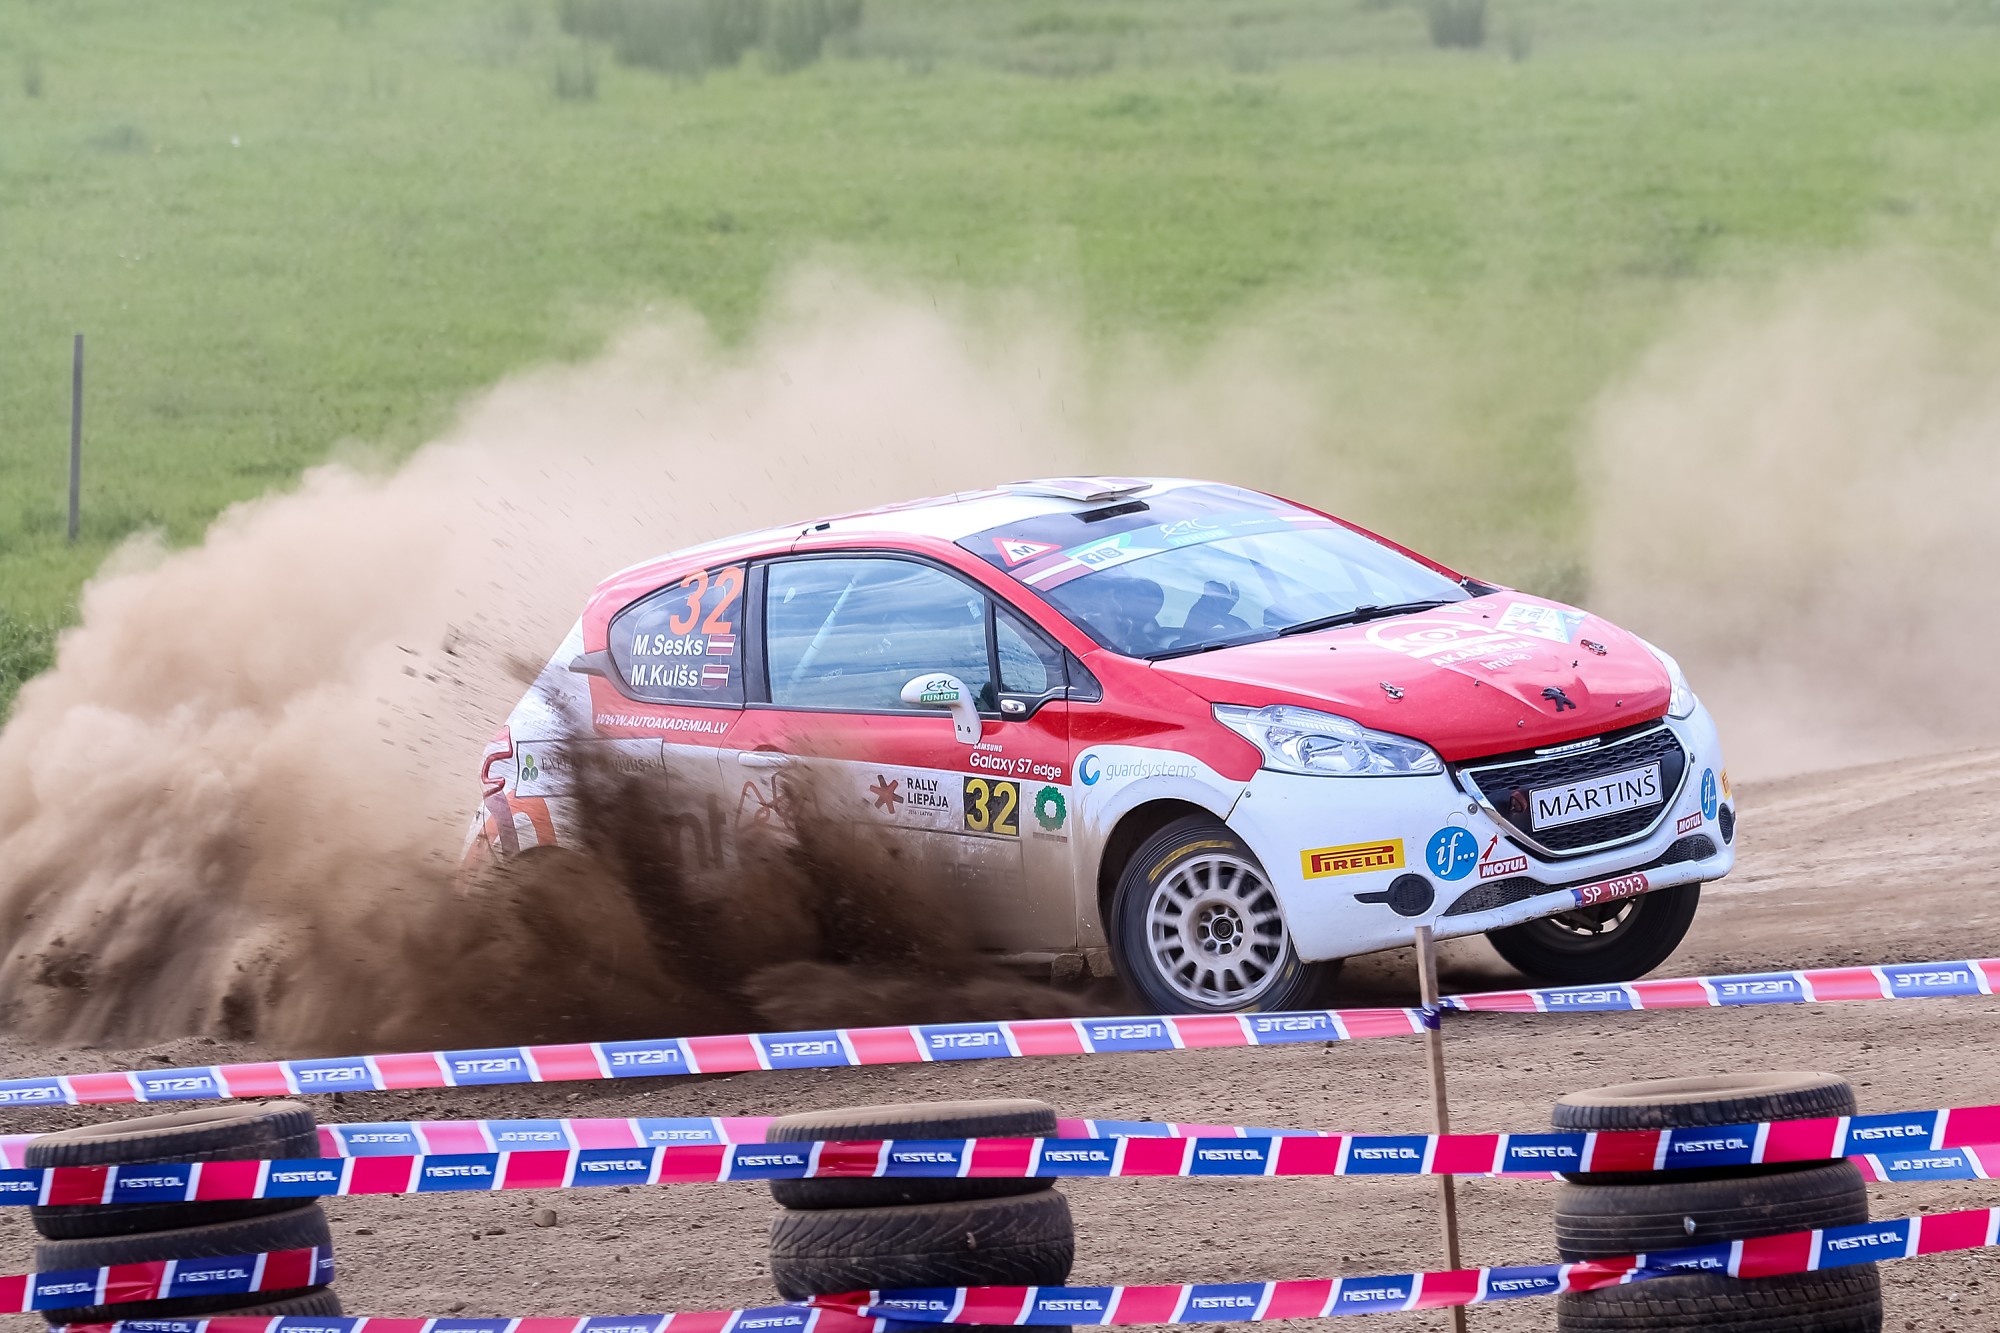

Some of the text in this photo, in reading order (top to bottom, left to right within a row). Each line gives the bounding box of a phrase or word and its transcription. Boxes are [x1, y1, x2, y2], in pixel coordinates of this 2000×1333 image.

[670, 566, 744, 635] 32
[632, 634, 704, 656] M.Sesks
[630, 663, 698, 686] M.Kulšs
[922, 691, 958, 702] JUNIOR
[596, 713, 729, 734] WWW.AUTOAKADEMIJA.LV
[973, 742, 1003, 752] SAMSUNG
[969, 752, 1062, 781] Galaxy S7 edge
[1106, 760, 1197, 781] guardsystems
[907, 778, 938, 792] RALLY
[907, 790, 949, 809] LIEPĀJA
[1539, 769, 1656, 819] MĀRTIŅŠ
[965, 779, 1017, 835] 32
[1679, 814, 1701, 832] MOTUL
[1311, 846, 1394, 873] PIRELLI
[1482, 861, 1526, 876] MOTUL
[1583, 886, 1601, 904] SP
[1853, 1125, 1928, 1141] NESTE OIL
[1511, 1146, 1577, 1158] NESTE OIL
[1675, 1138, 1748, 1153] NESTE OIL
[893, 1152, 957, 1163] NESTE OIL
[1045, 1151, 1110, 1162] NESTE OIL
[1198, 1148, 1263, 1160] NESTE OIL
[1354, 1147, 1419, 1159] NESTE OIL
[581, 1161, 646, 1172] NESTE OIL
[738, 1155, 803, 1166] NESTE OIL
[272, 1170, 337, 1182] NESTE OIL
[426, 1166, 491, 1177] NESTE OIL
[20, 1181, 39, 1191] OIL
[120, 1177, 184, 1188] NESTE OIL
[1828, 1233, 1902, 1251] NESTE OIL
[1700, 1257, 1722, 1269] OIL
[178, 1268, 249, 1283] NESTE OIL
[37, 1283, 93, 1296] NESTE OIL
[1491, 1278, 1554, 1292] NESTE OIL
[1343, 1289, 1406, 1302] NESTE OIL
[930, 1300, 948, 1310] OIL
[1039, 1299, 1103, 1310] NESTE OIL
[1192, 1297, 1255, 1309] NESTE OIL
[127, 1321, 191, 1332] NESTE OIL
[740, 1316, 803, 1329] NESTE OIL
